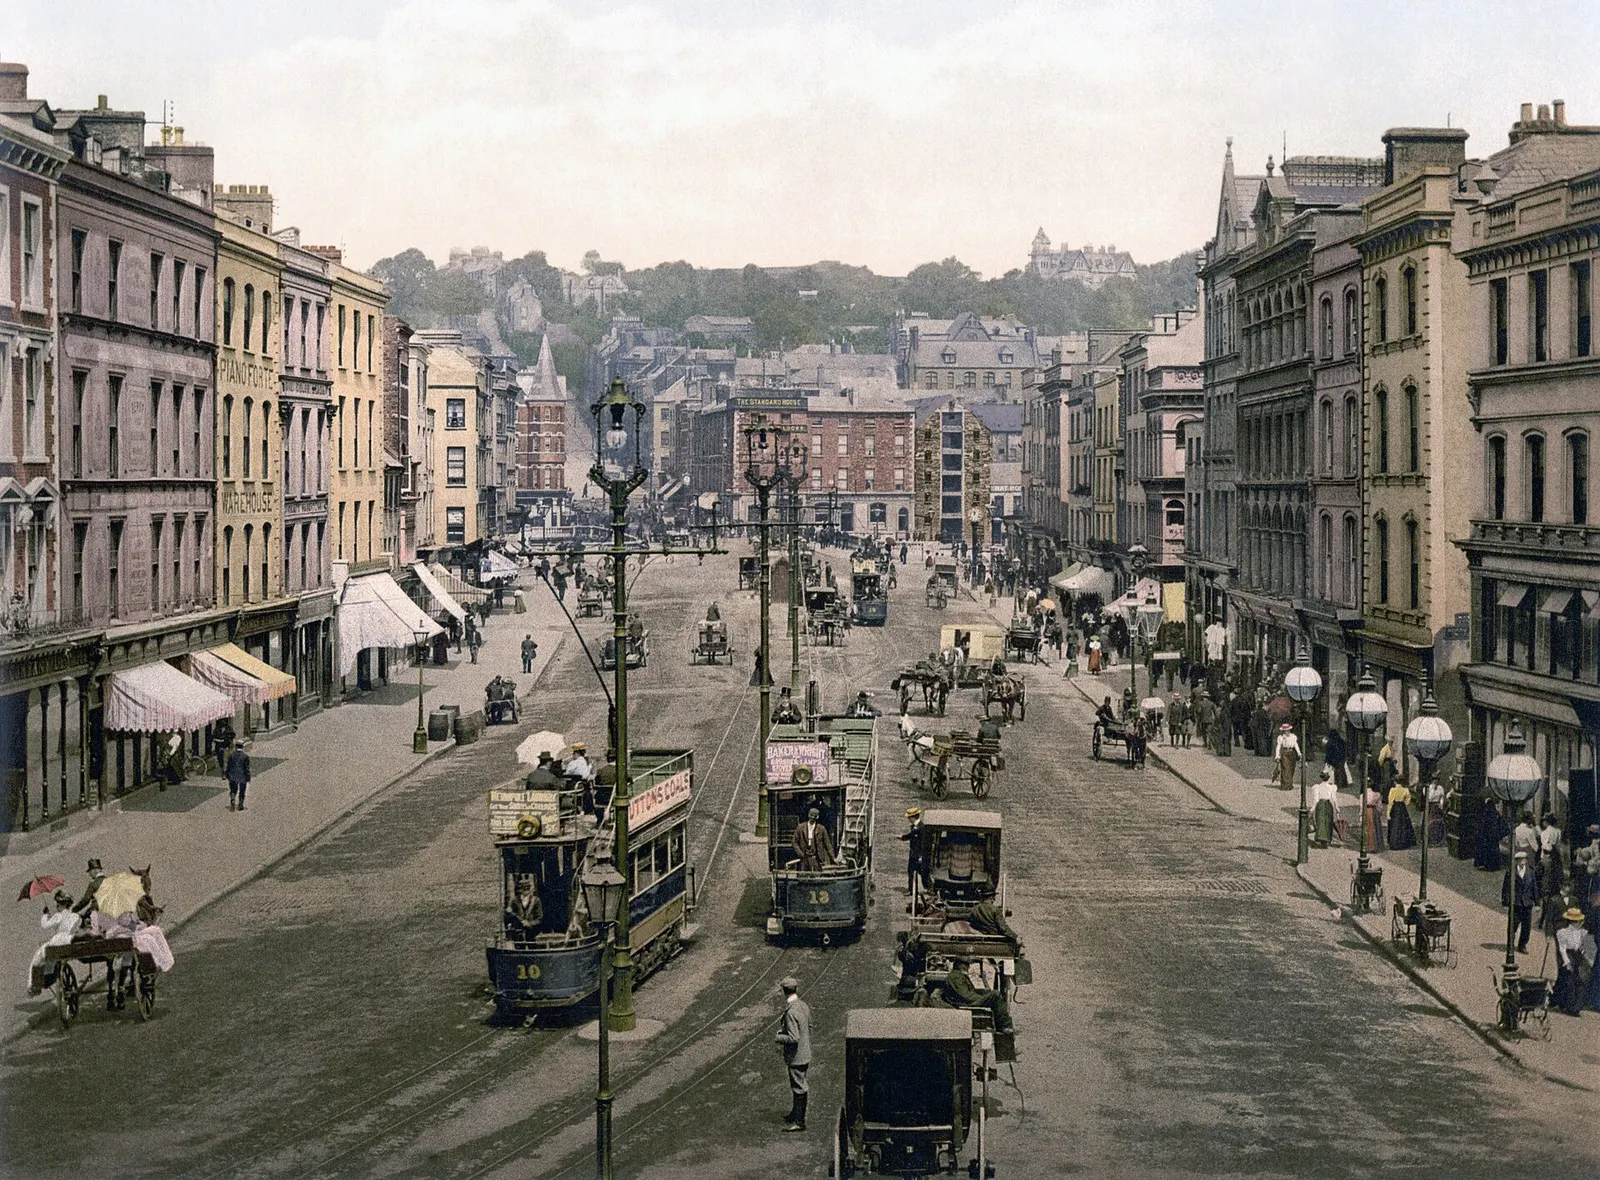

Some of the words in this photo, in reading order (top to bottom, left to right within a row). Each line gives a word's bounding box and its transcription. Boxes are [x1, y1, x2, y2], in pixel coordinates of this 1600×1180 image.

[220, 358, 274, 389] PIANOFORTE
[221, 491, 272, 514] WAREHOUSE
[629, 786, 663, 820] UTTONS
[808, 890, 830, 905] 13
[517, 964, 541, 980] 10
